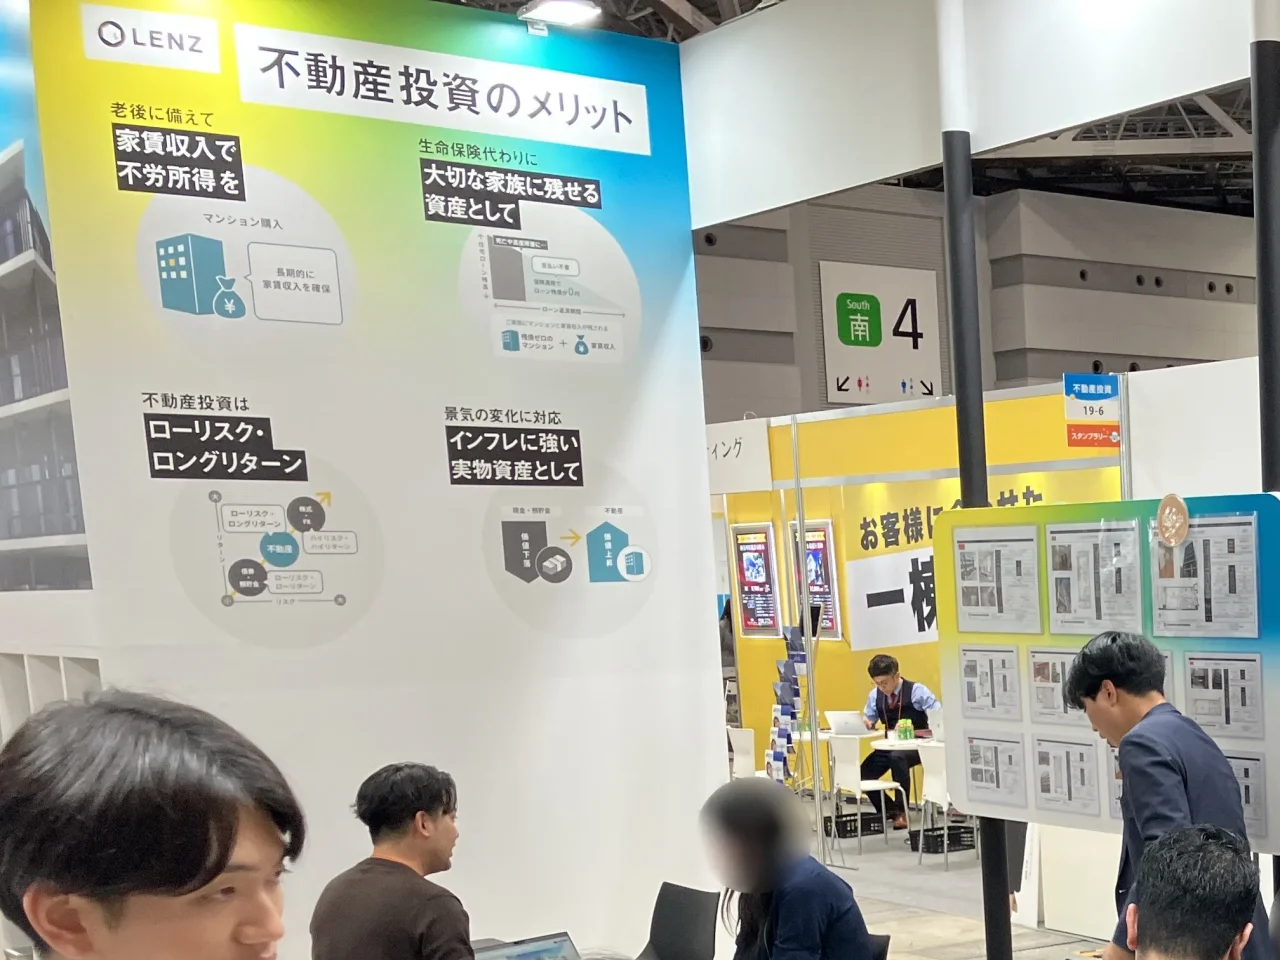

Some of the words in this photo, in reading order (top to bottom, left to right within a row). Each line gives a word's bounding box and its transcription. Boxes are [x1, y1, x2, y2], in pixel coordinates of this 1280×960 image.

[132, 27, 204, 54] LENZ
[256, 45, 634, 134] 不動産投資のメリット
[110, 101, 215, 127] 老後に備えて
[114, 127, 237, 163] 家賃収入で
[418, 137, 538, 167] 生命保険代わりに
[116, 160, 240, 196] 不労所得を
[423, 162, 600, 205] 大切な家族に残せる
[424, 192, 516, 224] 資産として
[202, 212, 284, 231] マンション購入
[275, 267, 316, 280] 長期的に
[262, 279, 332, 294] 家賃収入を確保
[846, 298, 871, 311] South
[849, 312, 870, 342] 南
[892, 298, 924, 350] 4
[521, 341, 555, 351] マンション
[1072, 383, 1112, 395] 不動産投資
[141, 392, 250, 412] 不動産投資は
[1083, 405, 1105, 416] 19-6
[444, 406, 562, 425] 景気の変化に対応
[148, 420, 264, 443] ローリスク・
[449, 430, 579, 454] インフレに強い
[152, 450, 303, 475] ロングリターン
[451, 458, 580, 481] 実物資産として
[266, 544, 293, 554] 不動産
